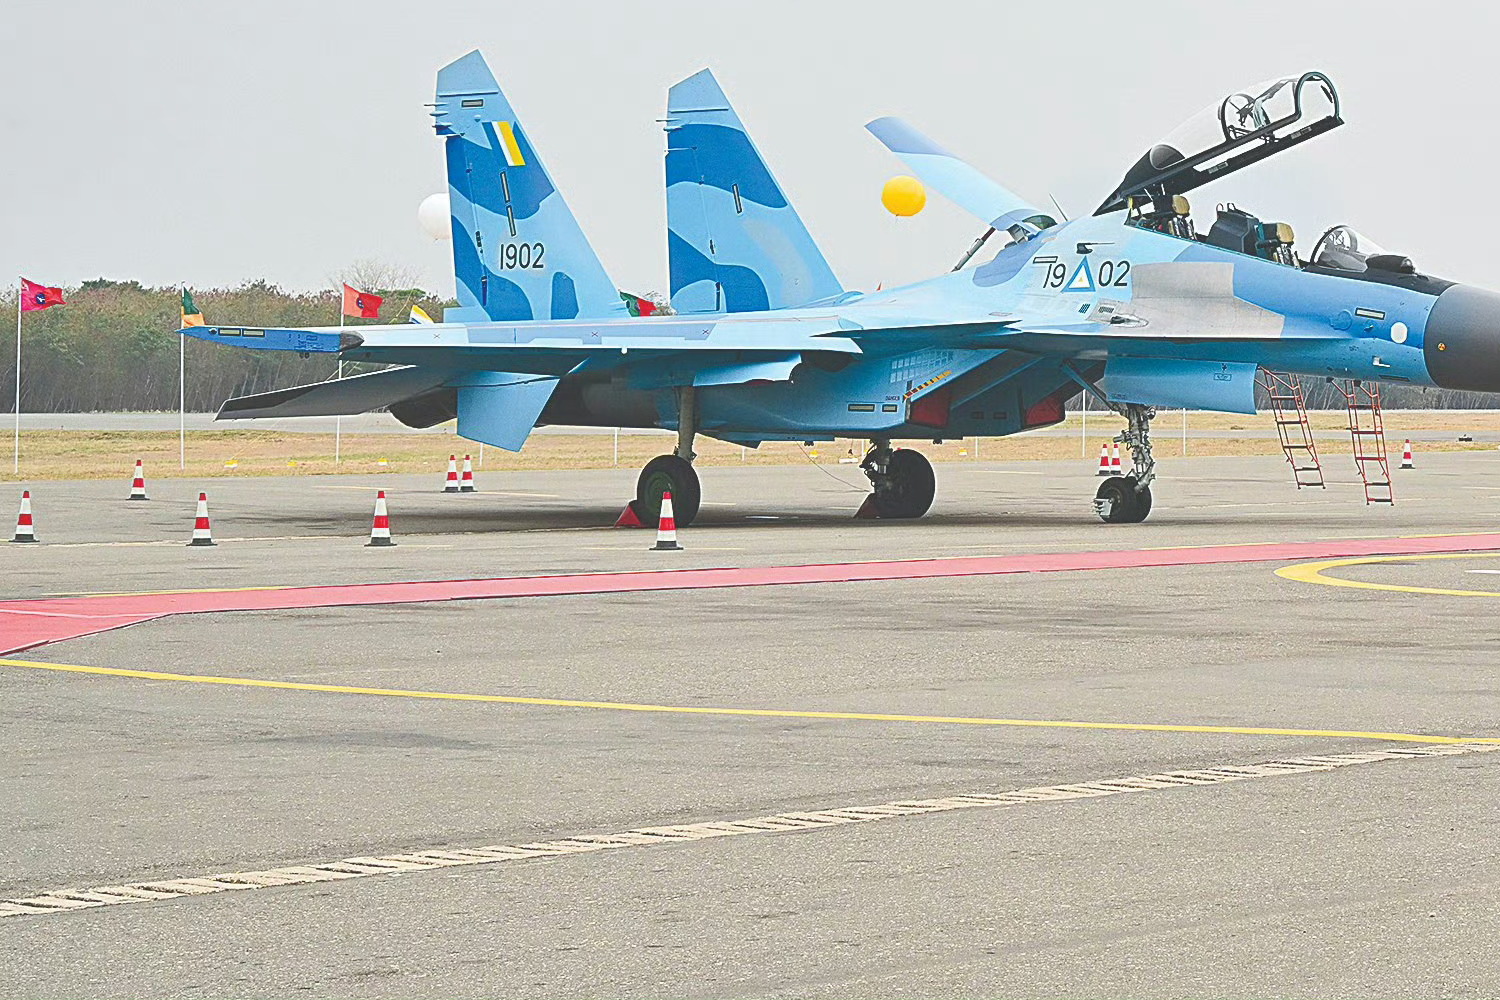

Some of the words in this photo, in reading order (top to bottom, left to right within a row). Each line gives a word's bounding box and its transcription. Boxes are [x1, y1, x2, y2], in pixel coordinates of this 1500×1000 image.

[500, 242, 545, 270] 1902
[1043, 263, 1067, 289] 19
[1098, 260, 1131, 288] 02
